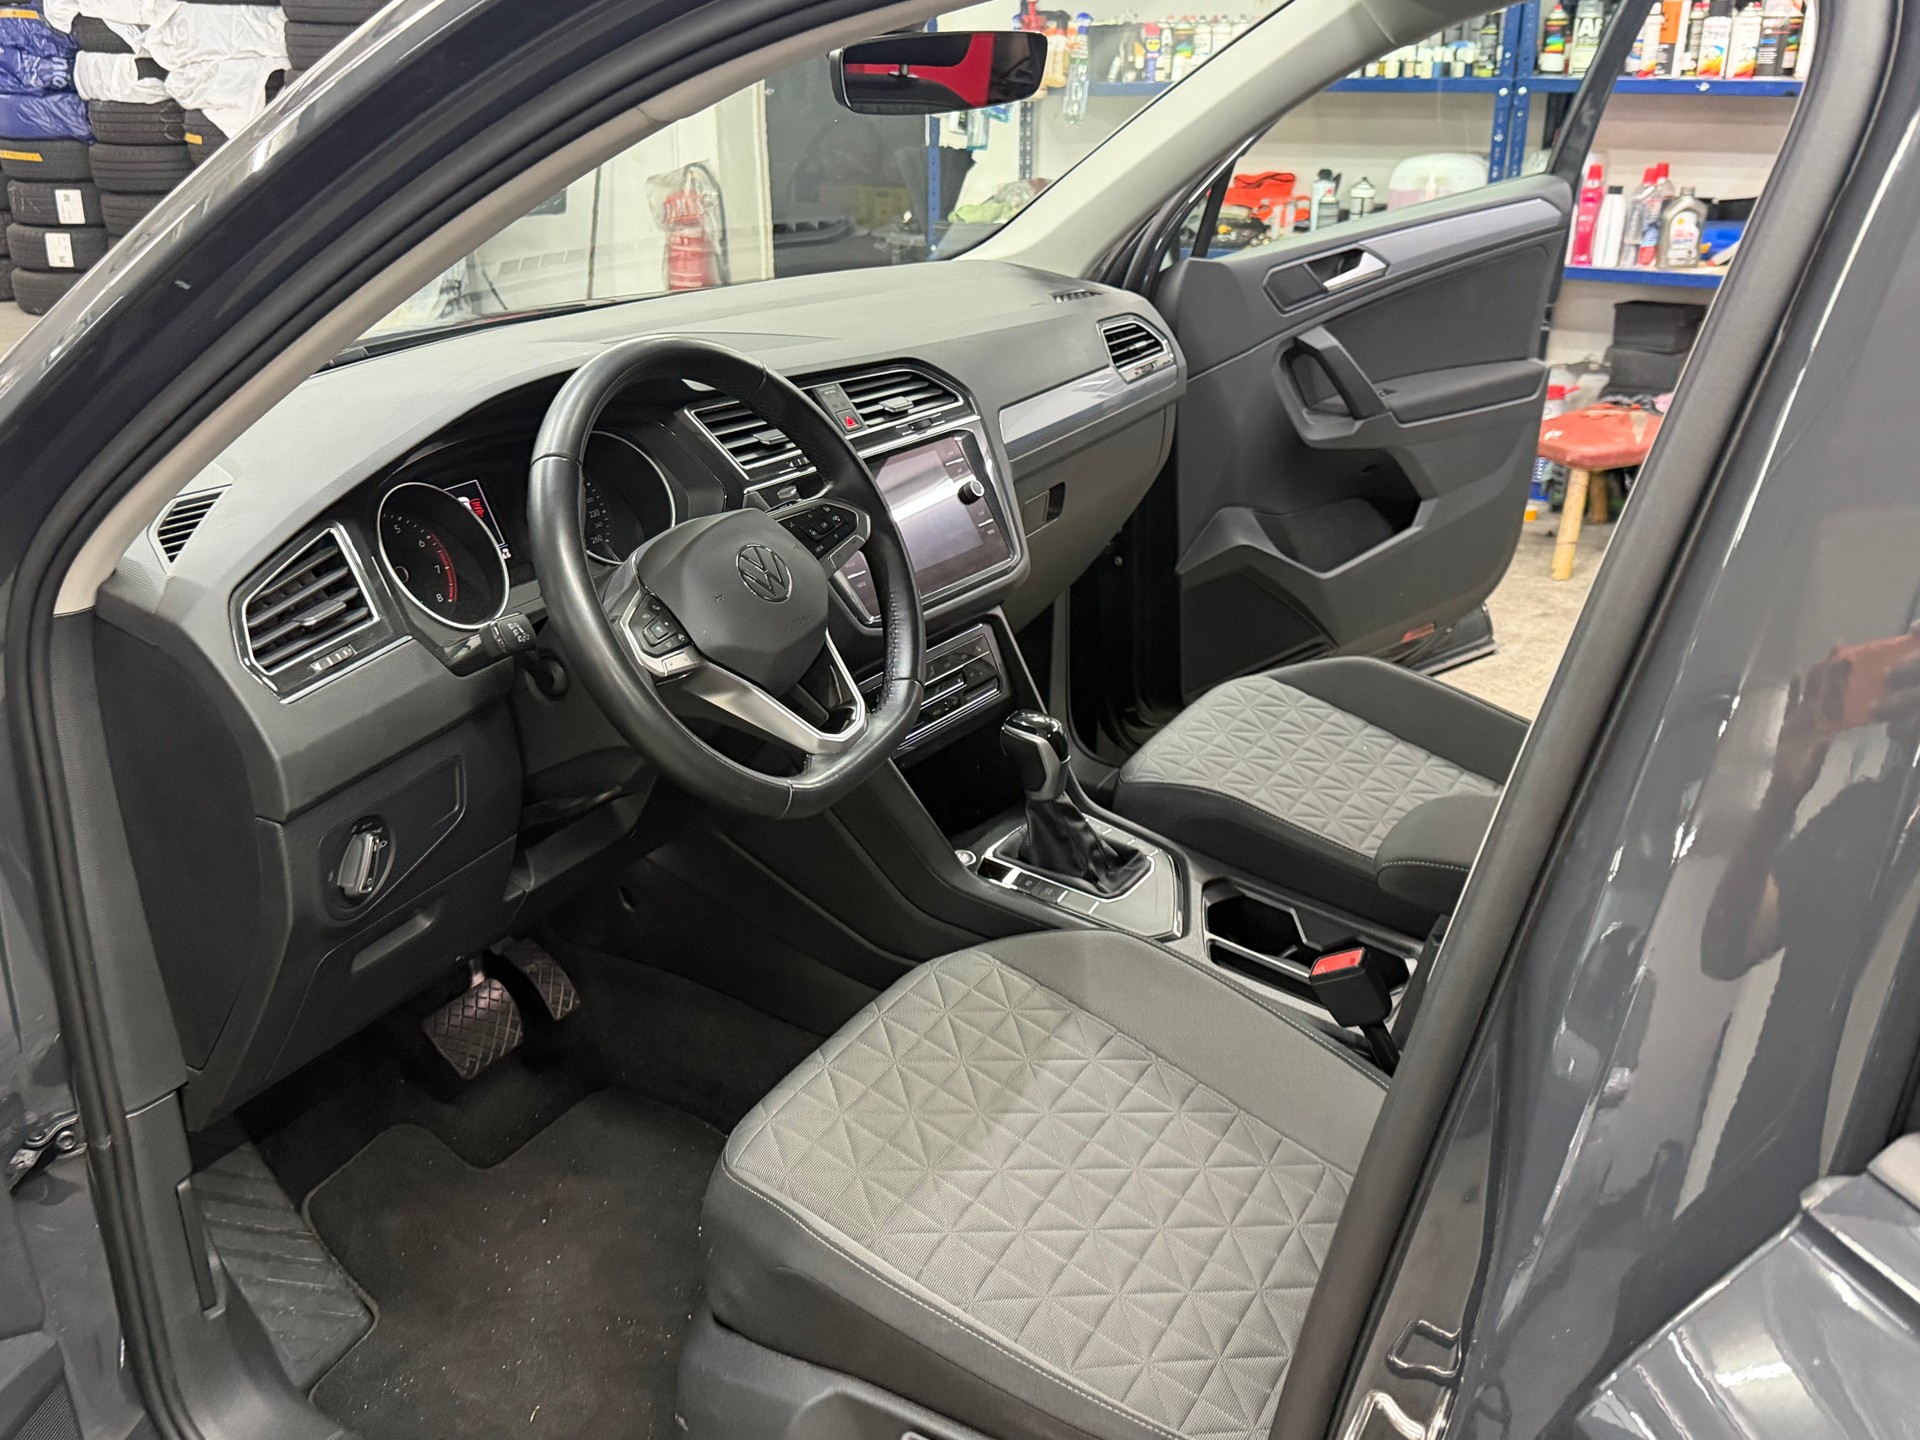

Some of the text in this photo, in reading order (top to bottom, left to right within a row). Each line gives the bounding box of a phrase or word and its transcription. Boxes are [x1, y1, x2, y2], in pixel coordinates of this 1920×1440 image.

[394, 524, 401, 534] 5
[418, 540, 425, 548] 6
[434, 565, 441, 574] 7
[436, 593, 444, 603] 8
